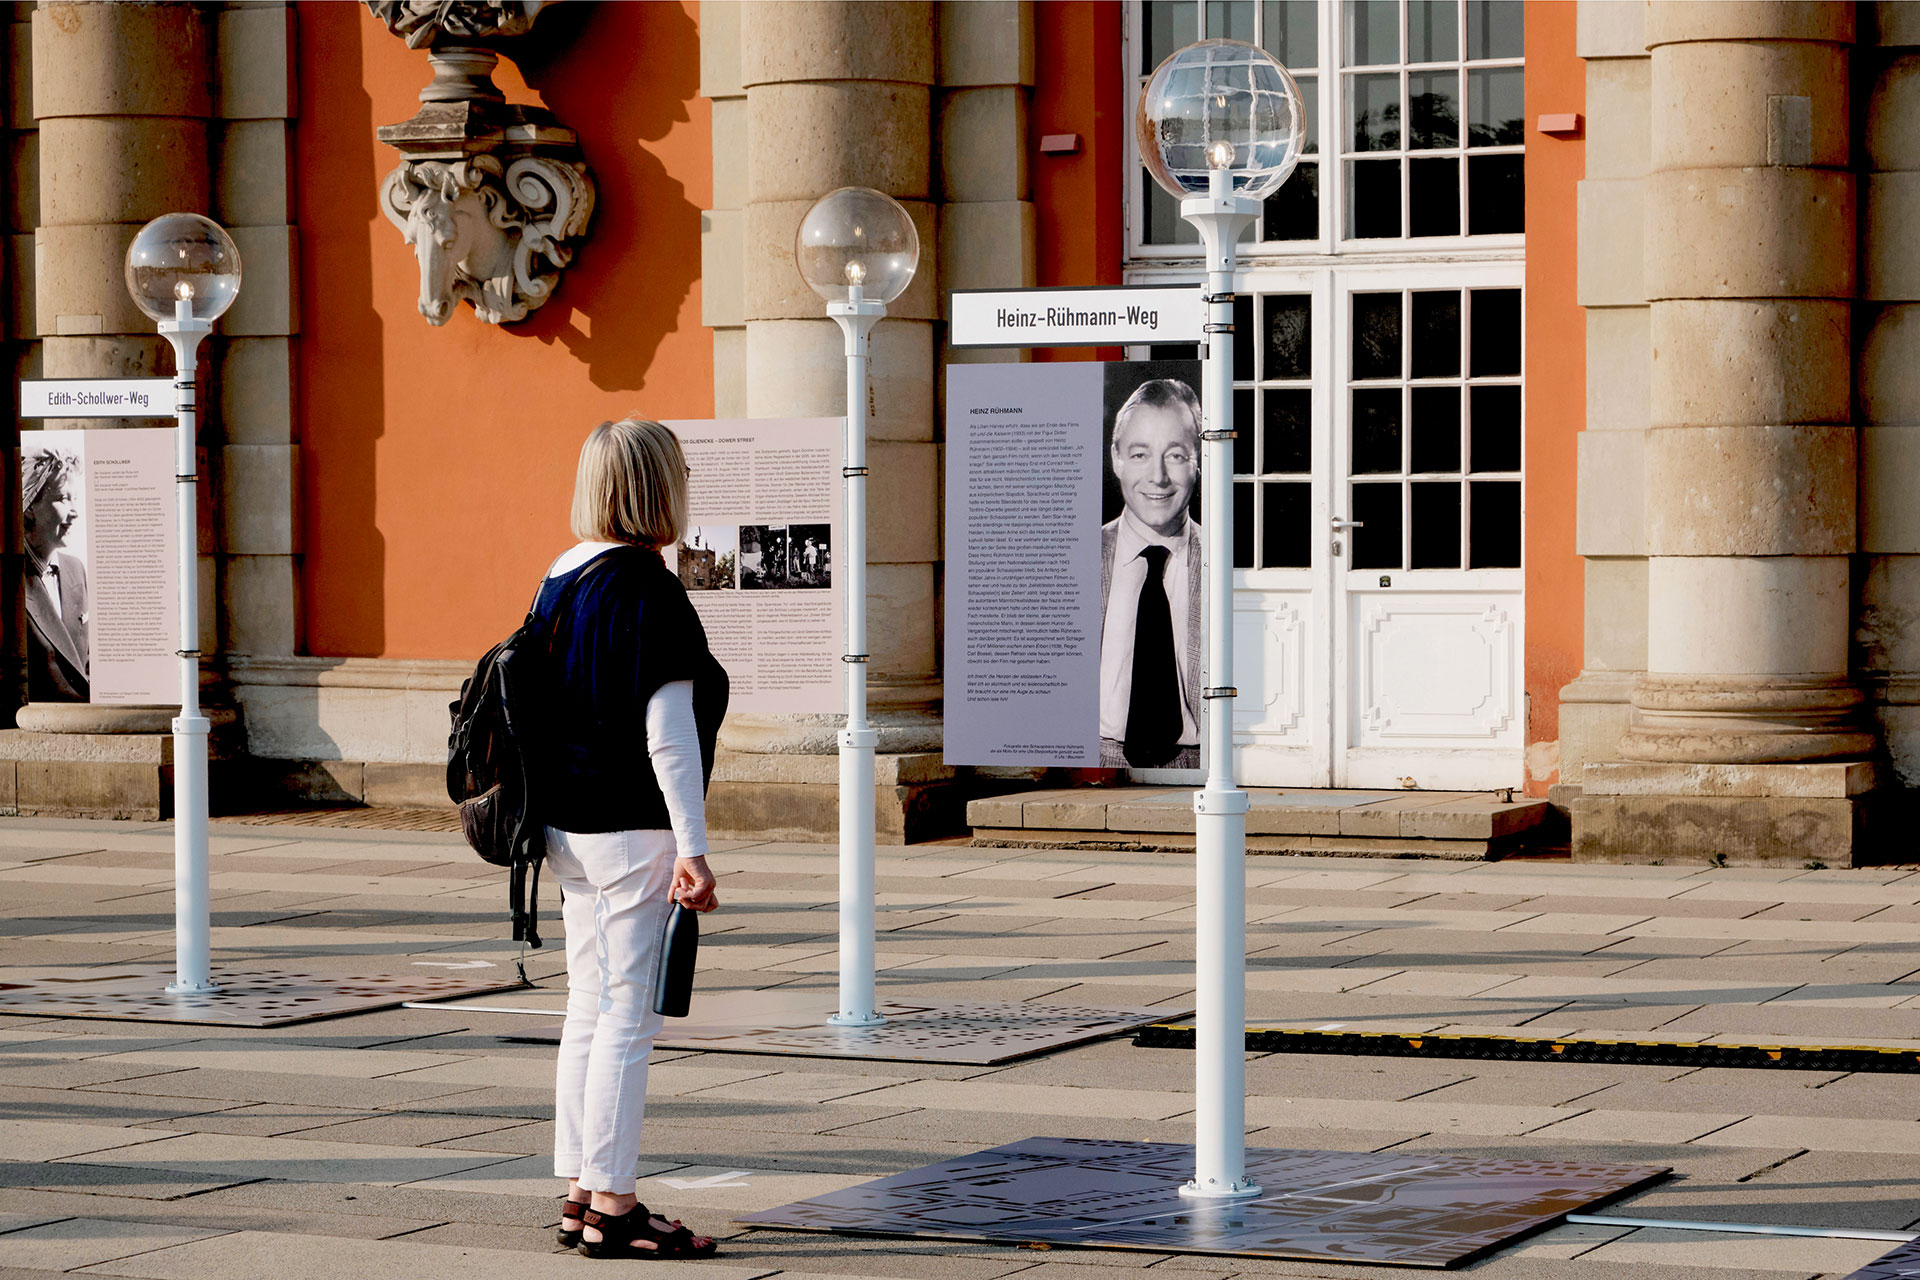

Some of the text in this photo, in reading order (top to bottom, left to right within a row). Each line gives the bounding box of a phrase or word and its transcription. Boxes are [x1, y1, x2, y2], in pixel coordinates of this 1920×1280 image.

[997, 306, 1158, 330] Heinz-Rühmann-Weg
[48, 391, 149, 408] Edith-Schollwer-Weg
[990, 406, 1023, 414] RÜHMANN
